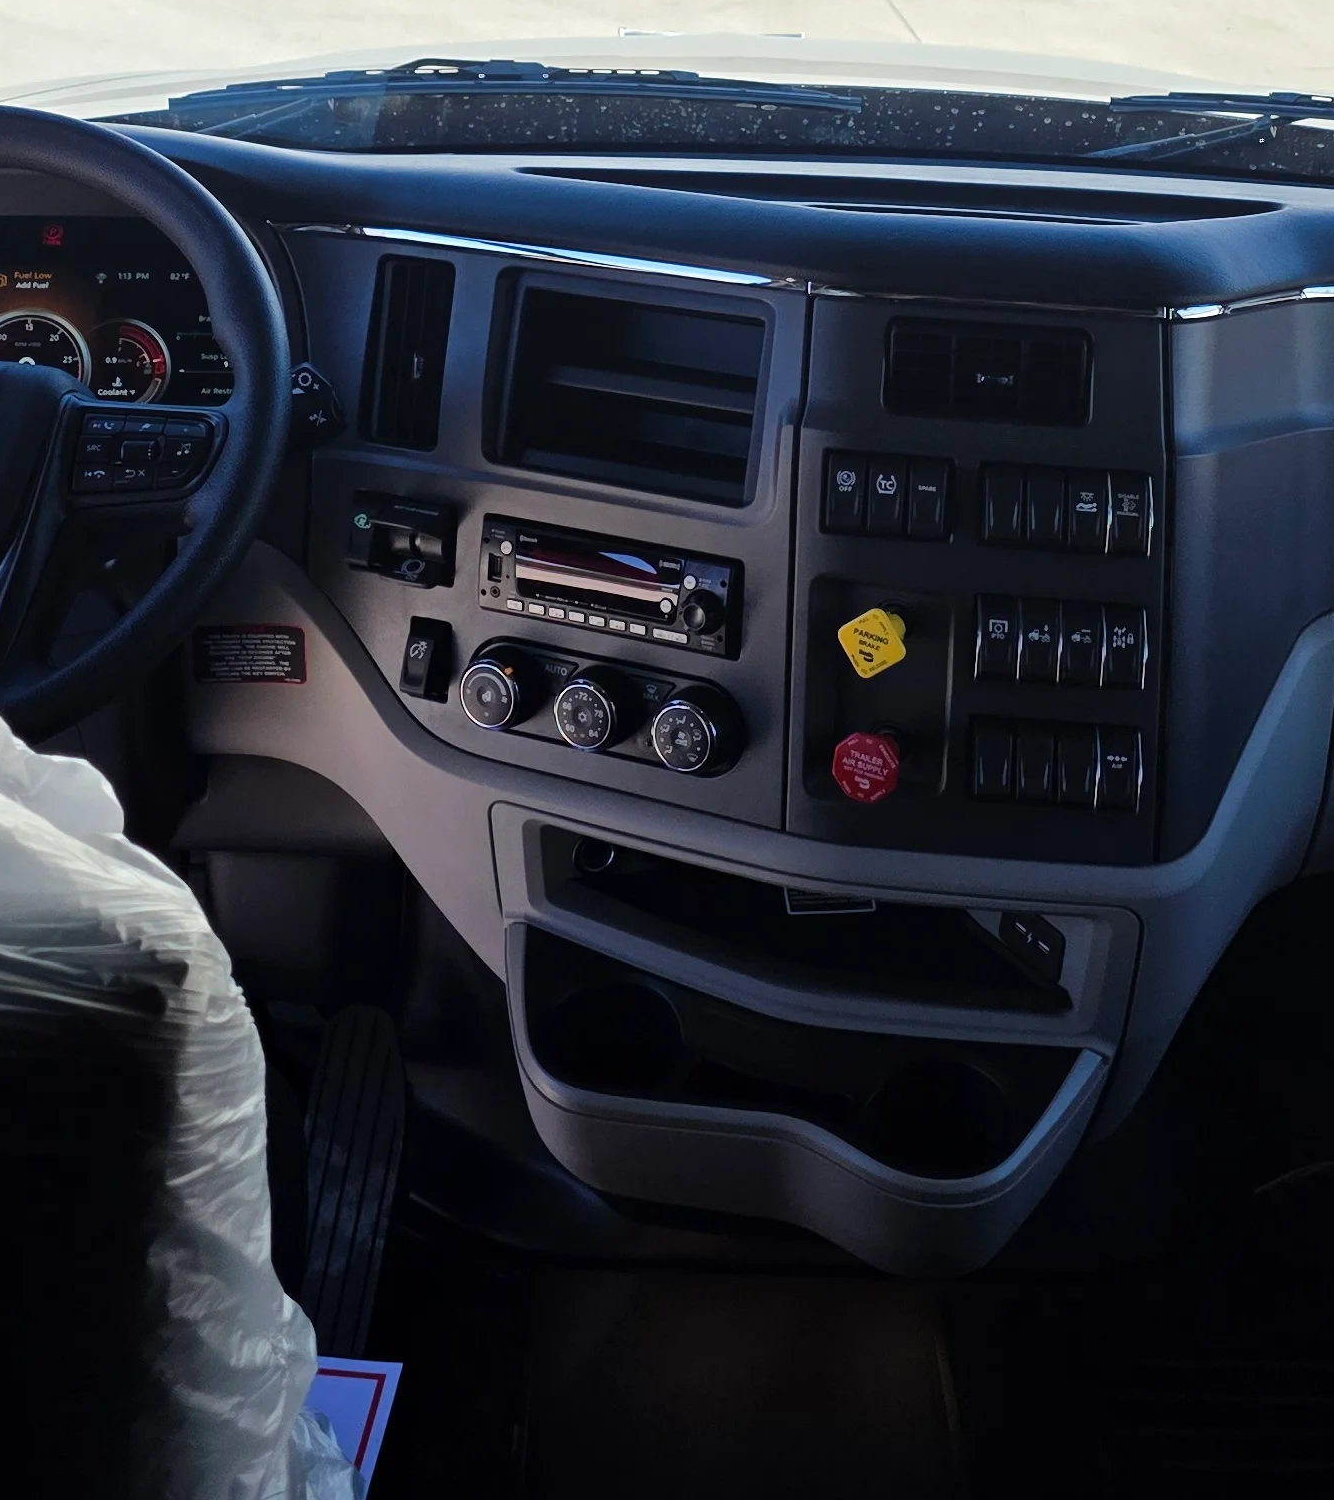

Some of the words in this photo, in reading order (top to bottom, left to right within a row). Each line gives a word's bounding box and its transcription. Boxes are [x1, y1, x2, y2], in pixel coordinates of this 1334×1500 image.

[14, 272, 33, 280] Fuel
[34, 272, 53, 280] Low
[118, 272, 132, 280] 1:13
[32, 281, 49, 289] Fuel
[25, 323, 34, 331] 15
[49, 334, 59, 342] 20
[97, 388, 128, 396] Coolant
[87, 444, 101, 452] SRC
[879, 480, 893, 490] TC
[853, 627, 889, 645] PARKING
[991, 632, 1005, 640] PTO
[859, 639, 881, 651] BRAKE
[544, 664, 567, 676] AUTO
[578, 691, 588, 701] 72
[594, 709, 603, 718] 78
[588, 729, 599, 738] 84
[850, 750, 883, 766] TRAILER
[842, 757, 855, 767] AIR
[857, 761, 889, 776] SUPPLY
